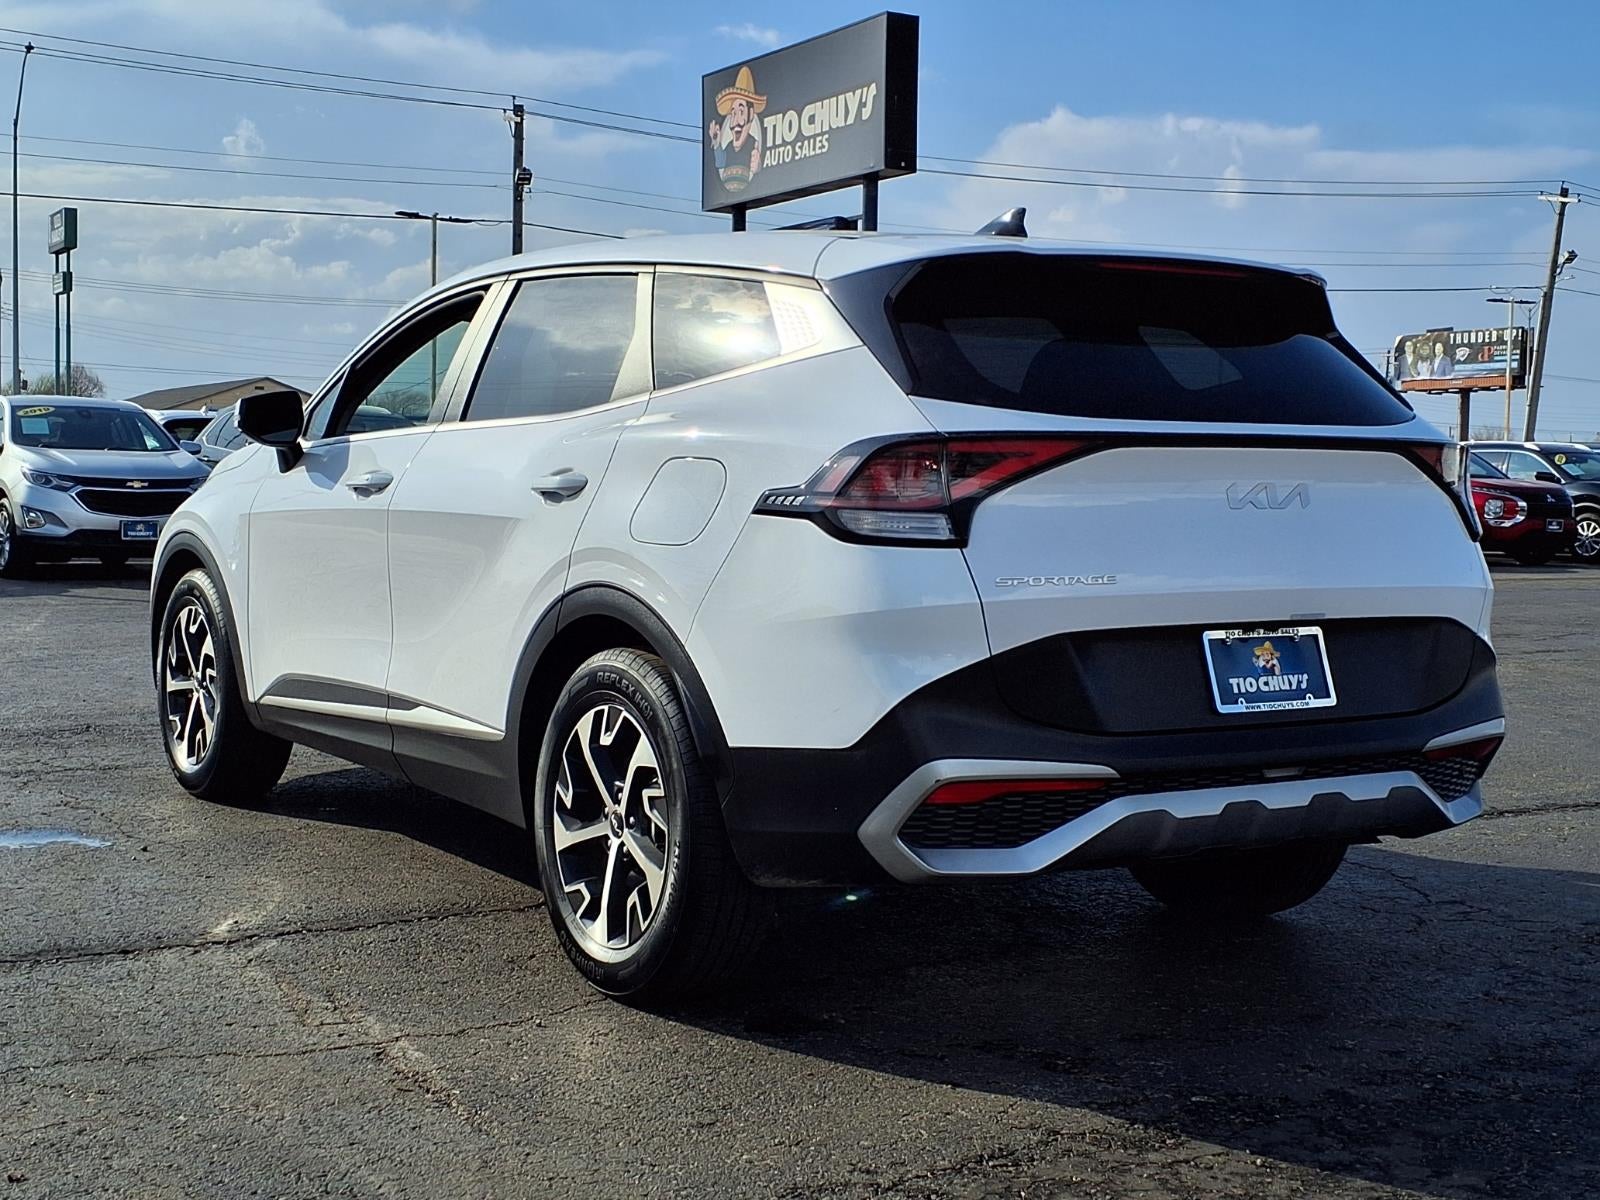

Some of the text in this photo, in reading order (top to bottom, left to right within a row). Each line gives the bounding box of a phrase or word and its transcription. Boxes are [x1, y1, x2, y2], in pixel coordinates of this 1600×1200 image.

[764, 82, 877, 148] TIO CHUY'S
[763, 134, 829, 168] AUTO SALES
[1449, 330, 1498, 345] THUNDER
[1225, 482, 1311, 510] KIA
[995, 574, 1117, 587] SPORTAGE
[596, 671, 635, 696] REFLEX
[1229, 673, 1309, 694] TIO CHUY'S
[1244, 701, 1310, 711] WWW.TIOCHUYS.COM
